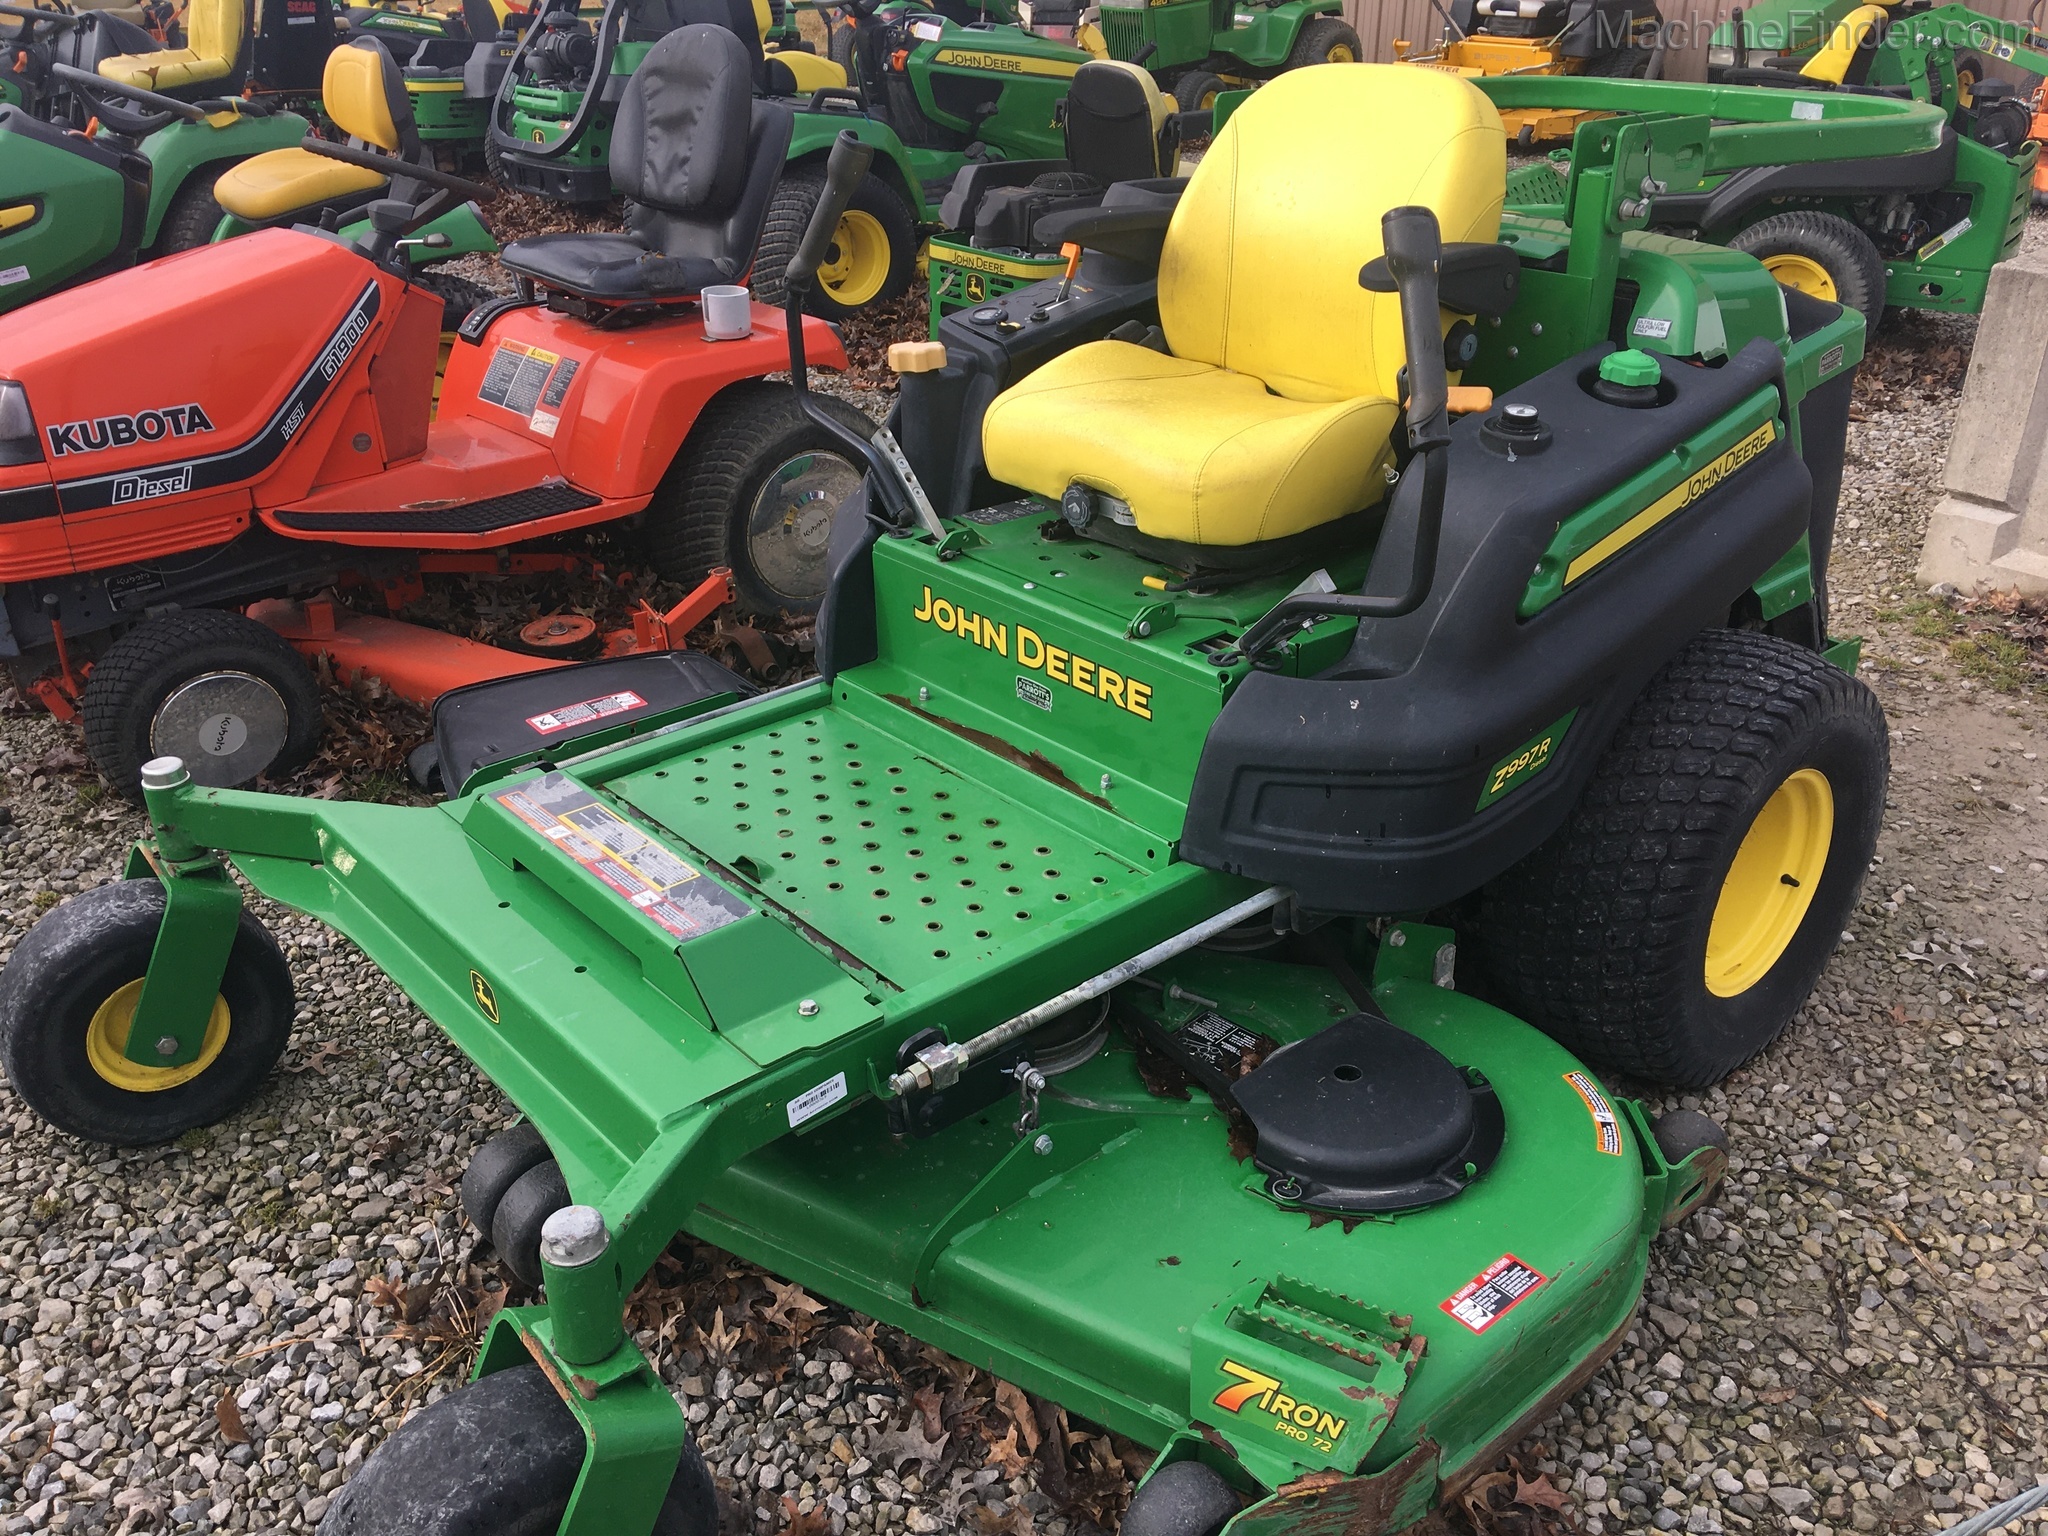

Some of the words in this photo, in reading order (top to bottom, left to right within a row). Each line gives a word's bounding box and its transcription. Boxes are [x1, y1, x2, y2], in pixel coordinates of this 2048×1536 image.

[948, 51, 982, 66] JOHN
[983, 55, 1022, 71] DEERE
[951, 252, 976, 268] JOHN
[976, 258, 1005, 274] DEERE
[320, 309, 369, 381] G1900
[46, 402, 216, 458] KUBOTA
[280, 401, 306, 441] HST
[112, 466, 192, 505] Diesel
[1682, 462, 1722, 505] JOHN
[1724, 430, 1768, 474] DEERE
[803, 518, 827, 537] Kubota
[913, 585, 1008, 658] JOHN
[1016, 623, 1152, 722] DEERE
[214, 717, 231, 752] Kubota
[1489, 737, 1551, 794] Z997R
[1455, 1282, 1479, 1300] DANGER
[1487, 1257, 1510, 1276] PELIGRO
[1275, 1421, 1309, 1442] PRO
[1311, 1436, 1333, 1453] 72
